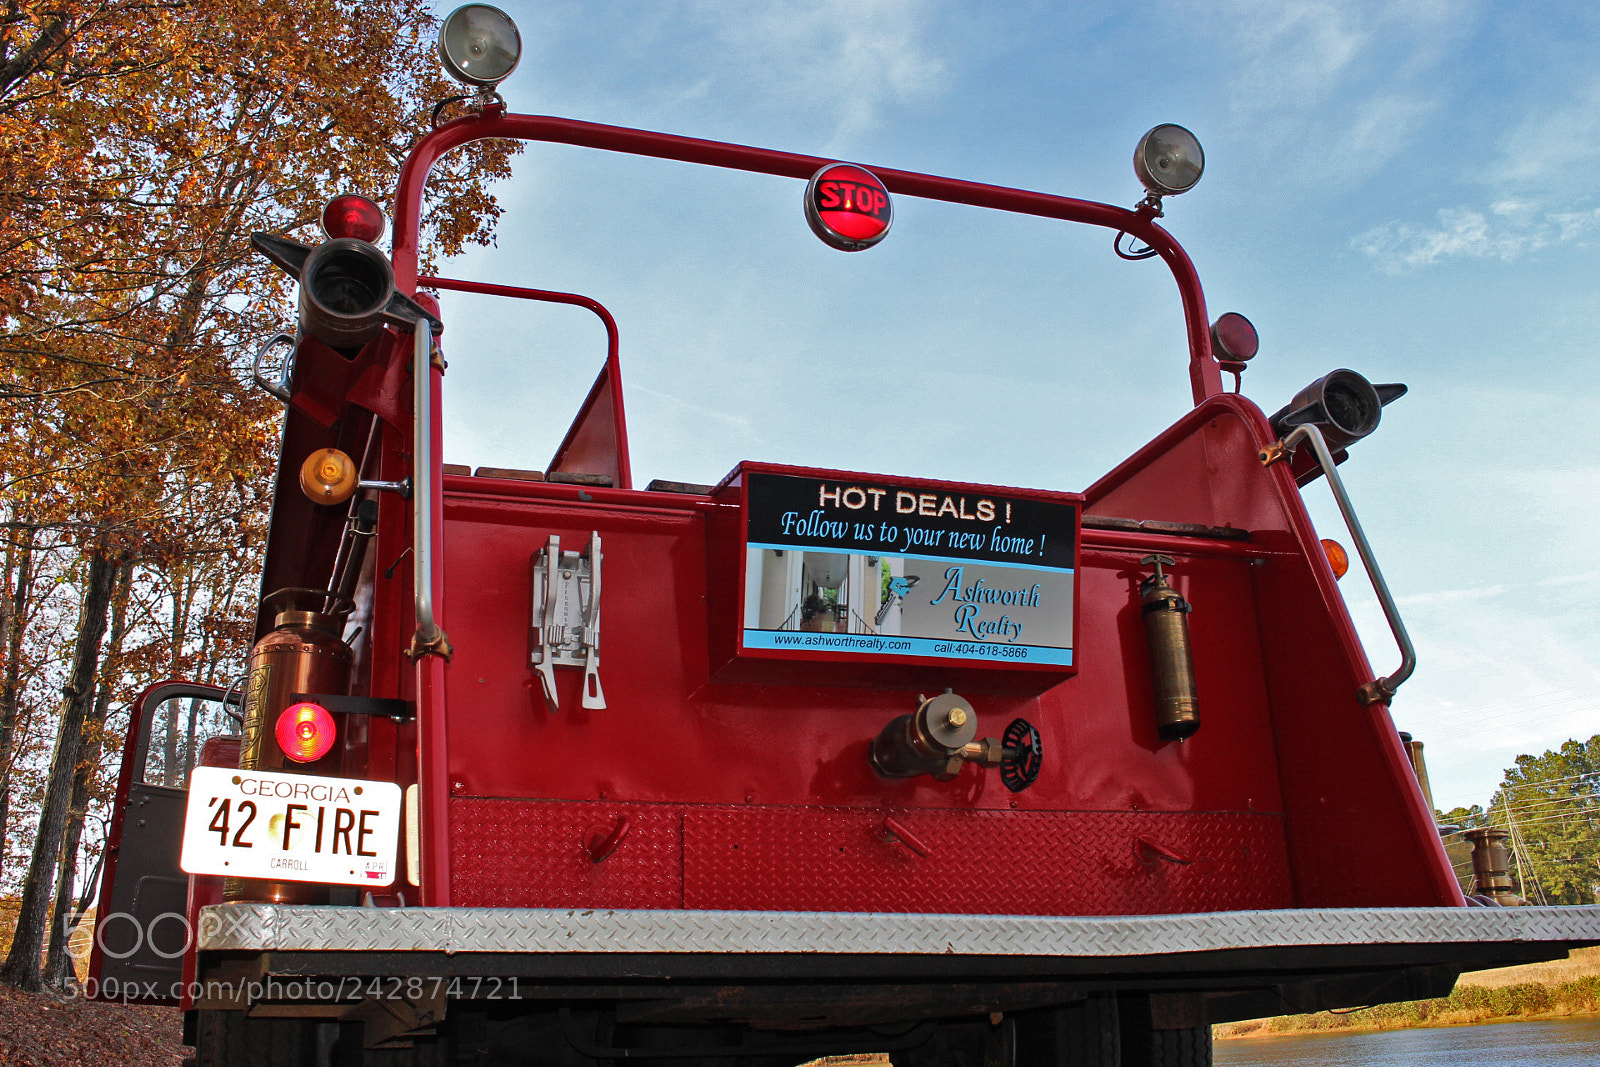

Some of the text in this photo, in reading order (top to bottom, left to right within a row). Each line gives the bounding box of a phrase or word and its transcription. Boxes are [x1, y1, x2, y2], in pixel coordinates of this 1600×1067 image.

[820, 181, 887, 215] STOP
[818, 484, 886, 511] HOT
[896, 491, 996, 522] DEALS
[781, 510, 849, 539] Follow
[853, 520, 875, 542] us
[879, 521, 898, 543] to
[900, 527, 945, 552] your
[948, 530, 986, 550] new
[990, 526, 1034, 555] home
[930, 566, 1041, 608] Ashworth
[954, 603, 1023, 642] Realty
[774, 634, 912, 652] www.ashworthrealty.com
[934, 642, 1028, 659] call:404-618-5866
[240, 778, 351, 804] GEORGIA
[282, 803, 380, 857] FIRE
[270, 857, 309, 871] CARROLL
